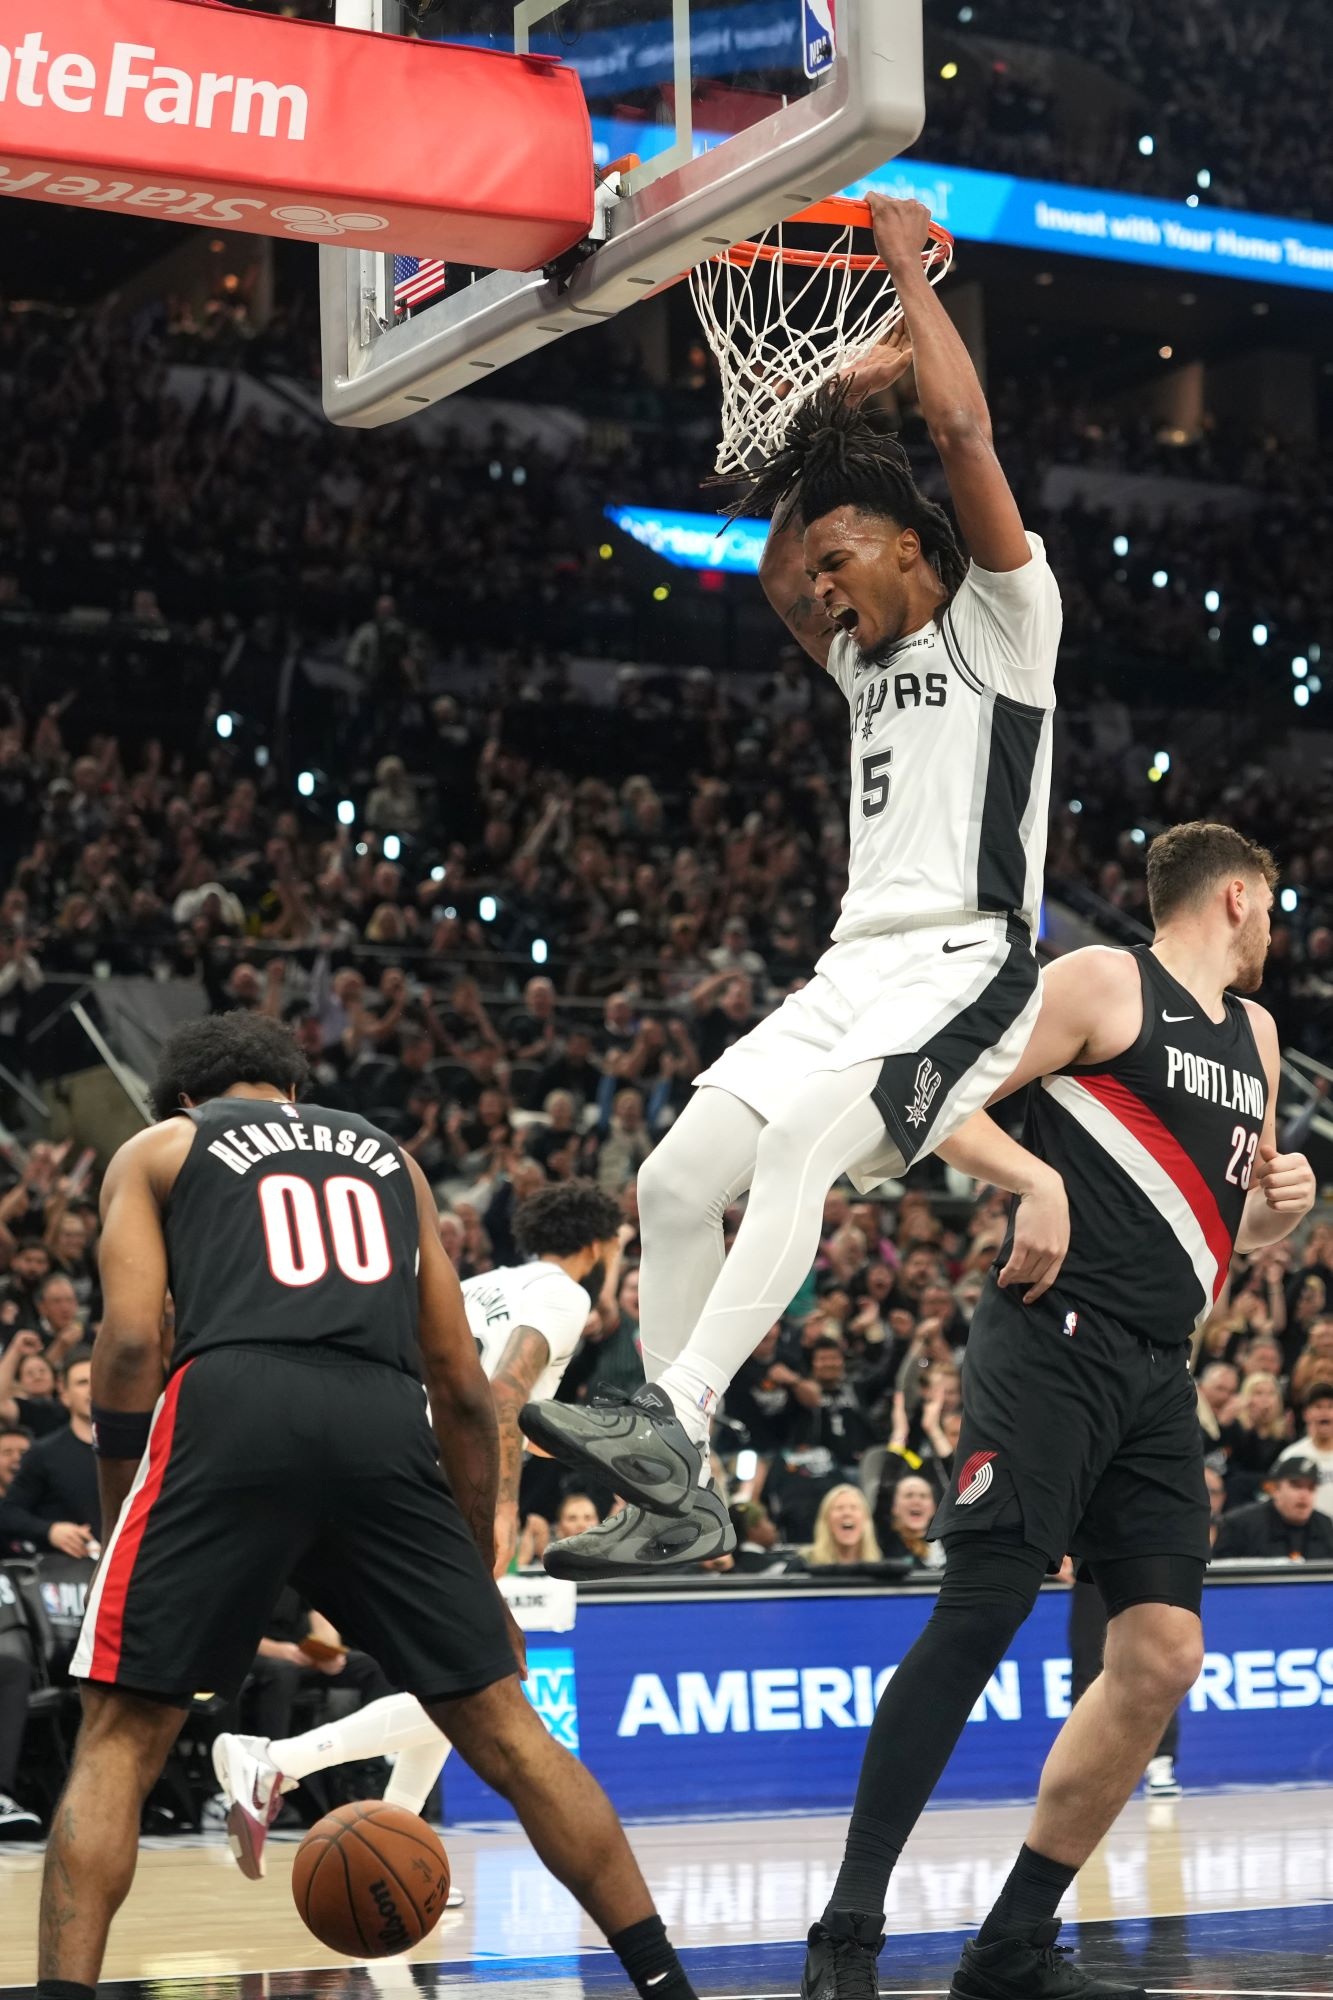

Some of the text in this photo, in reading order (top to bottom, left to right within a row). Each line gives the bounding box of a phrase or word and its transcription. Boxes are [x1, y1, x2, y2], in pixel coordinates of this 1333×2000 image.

[0, 32, 96, 112] te
[1035, 200, 1108, 238] Invest
[1109, 214, 1162, 246] with
[1162, 219, 1213, 253] Your
[1215, 228, 1283, 264] Home
[850, 672, 948, 741] PURS
[860, 747, 893, 821] 5
[1164, 1045, 1264, 1121] PORTLAND
[207, 1122, 401, 1178] HENDERSON
[1225, 1124, 1259, 1191] 23
[258, 1173, 393, 1288] 00
[617, 1648, 1333, 1737] AMERIN ERES
